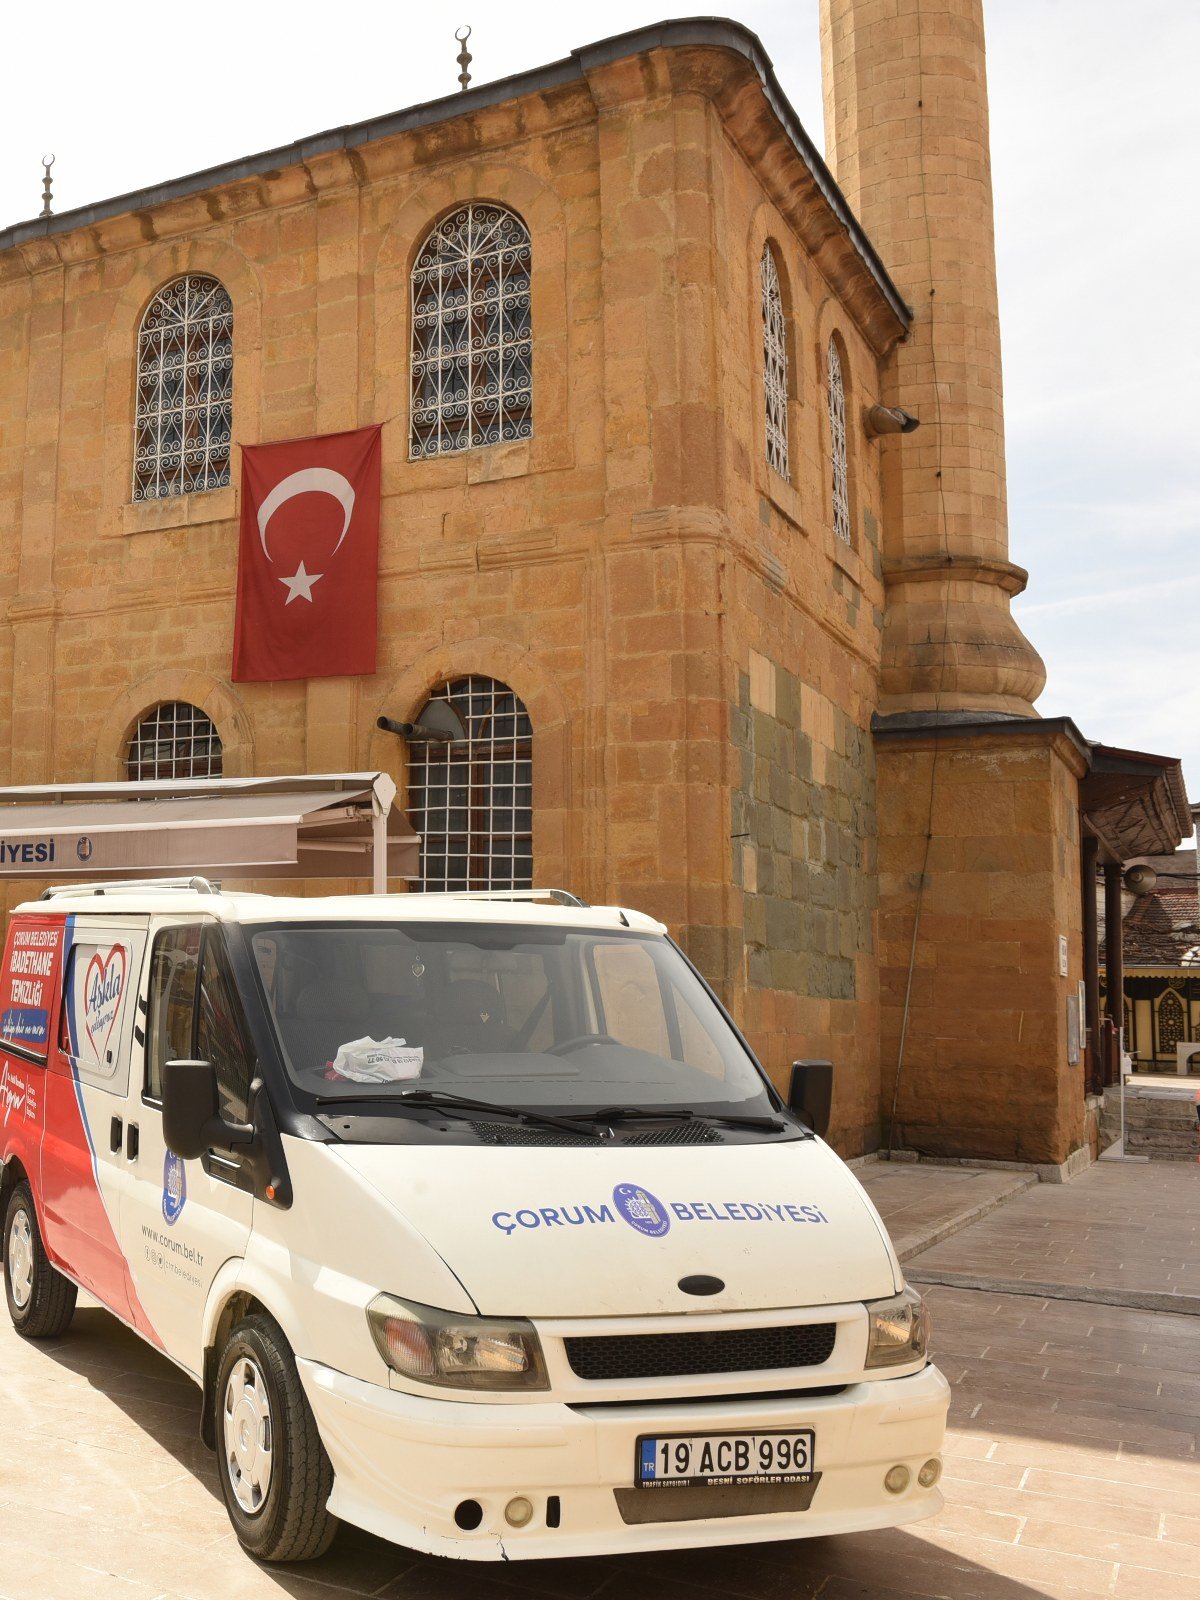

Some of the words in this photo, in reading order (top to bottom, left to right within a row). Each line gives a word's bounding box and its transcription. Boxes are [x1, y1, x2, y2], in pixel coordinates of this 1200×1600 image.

[13, 931, 32, 948] ÇORUM
[30, 930, 60, 947] BELEDİYESİ
[10, 951, 54, 976] İBADETHANE
[11, 979, 43, 1006] TEMİZLİĞİ
[89, 963, 121, 1012] Aşkla
[491, 1204, 616, 1235] ÇORUM
[670, 1201, 829, 1223] BELEDİYESİ
[141, 1224, 204, 1268] www.corum.bel.tr
[643, 1463, 655, 1472] TR
[661, 1442, 690, 1474] 19
[699, 1440, 750, 1473] ACB
[759, 1438, 808, 1470] 996
[707, 1476, 733, 1485] BESNİ
[783, 1475, 810, 1483] ODASI
